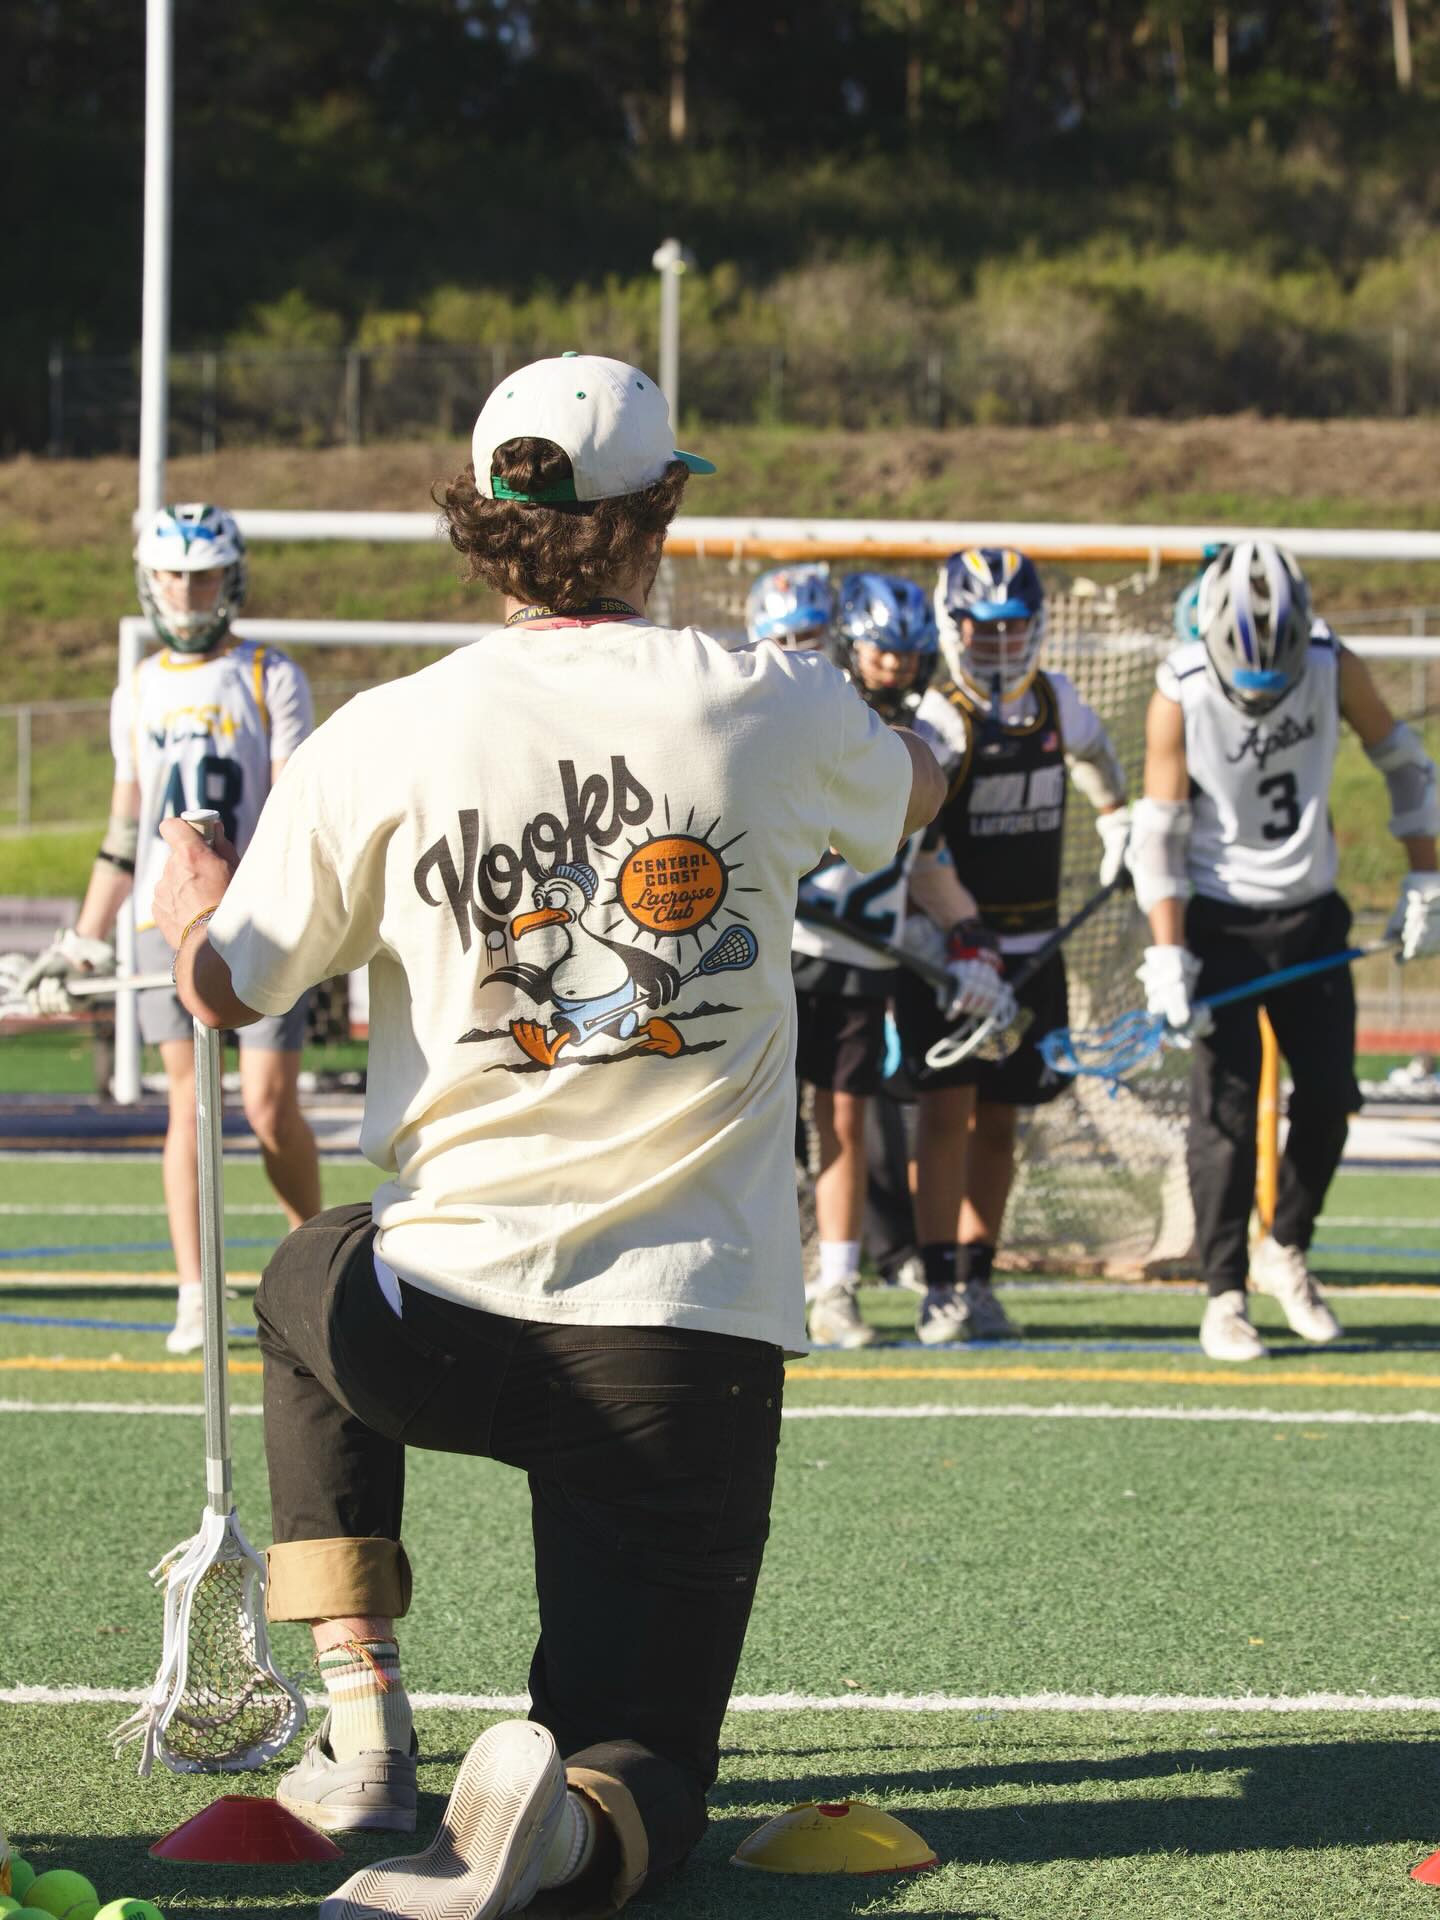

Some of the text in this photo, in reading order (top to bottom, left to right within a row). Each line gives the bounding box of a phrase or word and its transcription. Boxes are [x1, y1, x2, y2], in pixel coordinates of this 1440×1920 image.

[1257, 772, 1300, 841] 3
[414, 755, 653, 955] Kooks
[633, 853, 710, 873] CENTRAL
[645, 869, 699, 887] COAST
[631, 887, 716, 911] Lacrosse
[653, 899, 694, 924] Club
